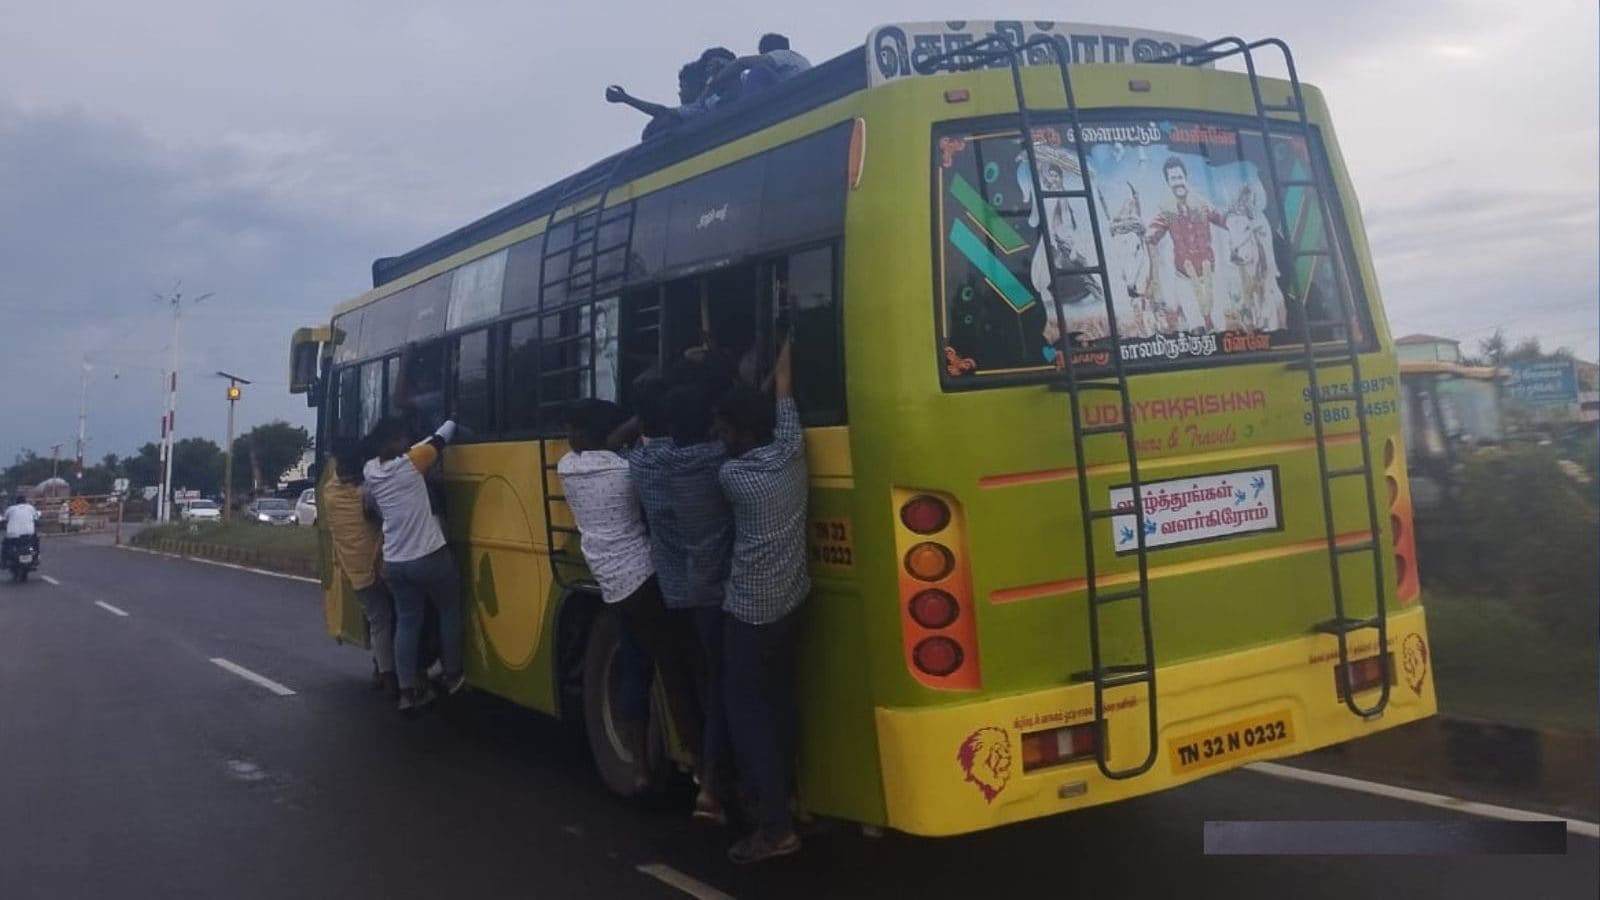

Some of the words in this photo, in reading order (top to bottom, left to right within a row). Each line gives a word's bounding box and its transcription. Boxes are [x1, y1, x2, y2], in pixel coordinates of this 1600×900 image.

[1178, 742, 1199, 766] TN
[1203, 736, 1225, 758] 32
[1227, 731, 1241, 752] N
[1244, 721, 1287, 747] 0232
